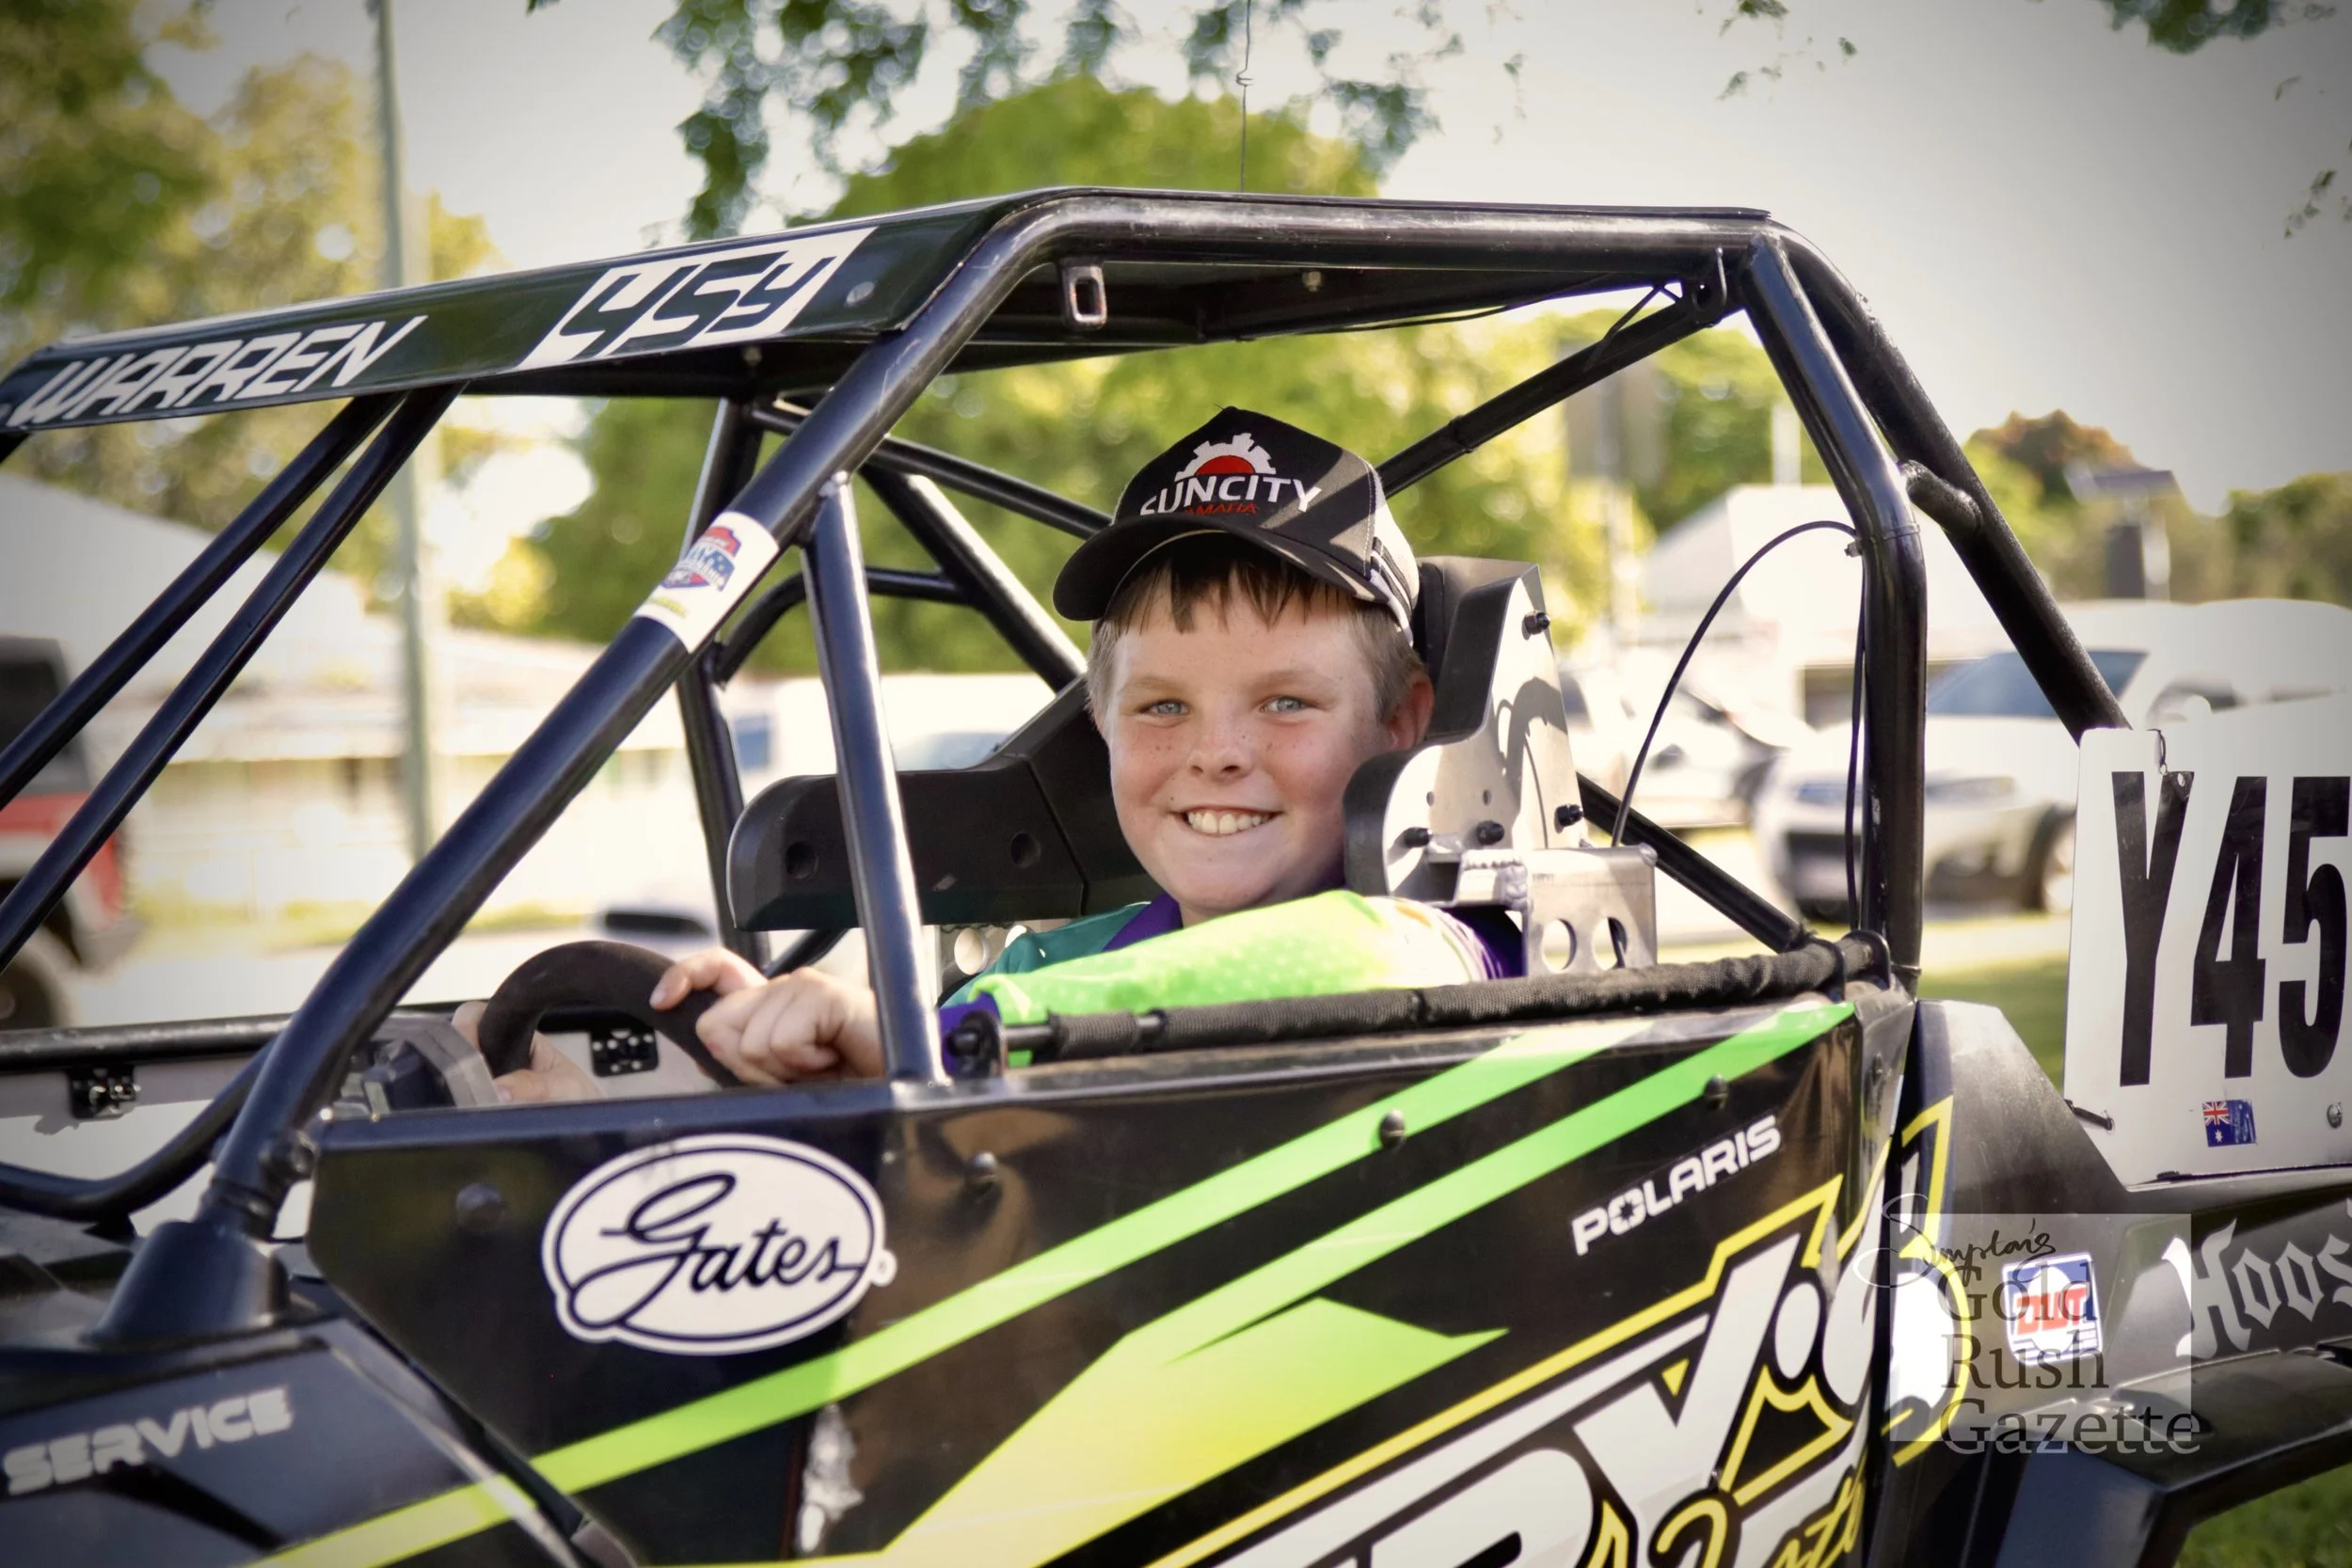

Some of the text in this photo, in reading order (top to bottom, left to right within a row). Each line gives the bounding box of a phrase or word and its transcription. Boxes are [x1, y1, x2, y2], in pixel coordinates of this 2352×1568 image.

[8, 315, 428, 427] WARREN
[567, 1170, 864, 1329] Gates
[1571, 1115, 1781, 1256] POLARIS
[2162, 1200, 2352, 1359] Hoos
[4, 1386, 293, 1496] SERVICE
